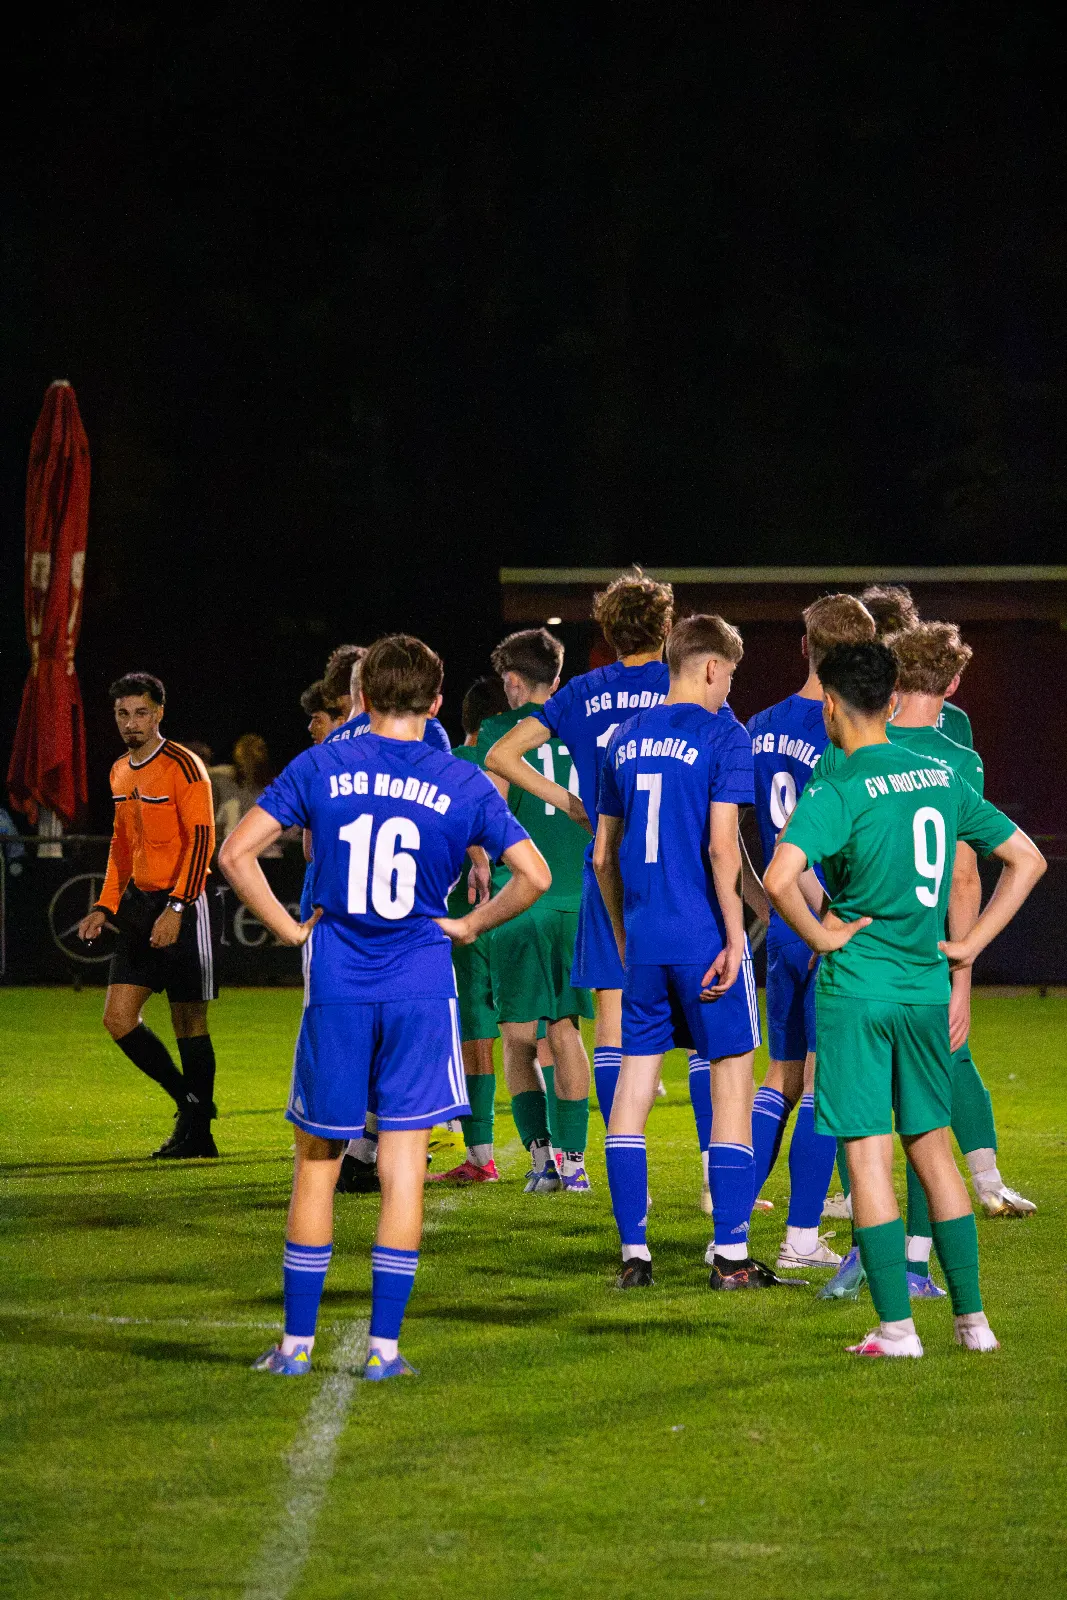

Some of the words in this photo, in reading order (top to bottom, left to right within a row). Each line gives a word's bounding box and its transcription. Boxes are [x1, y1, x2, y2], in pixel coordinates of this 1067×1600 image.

[585, 691, 613, 717] JSG
[616, 690, 667, 709] HoDi
[640, 737, 699, 766] HoDiLa
[329, 771, 369, 799] JSG
[373, 772, 452, 816] HoDiLa
[864, 776, 890, 799] GW
[636, 773, 663, 864] 7
[338, 813, 421, 920] 16
[912, 806, 946, 908] 9
